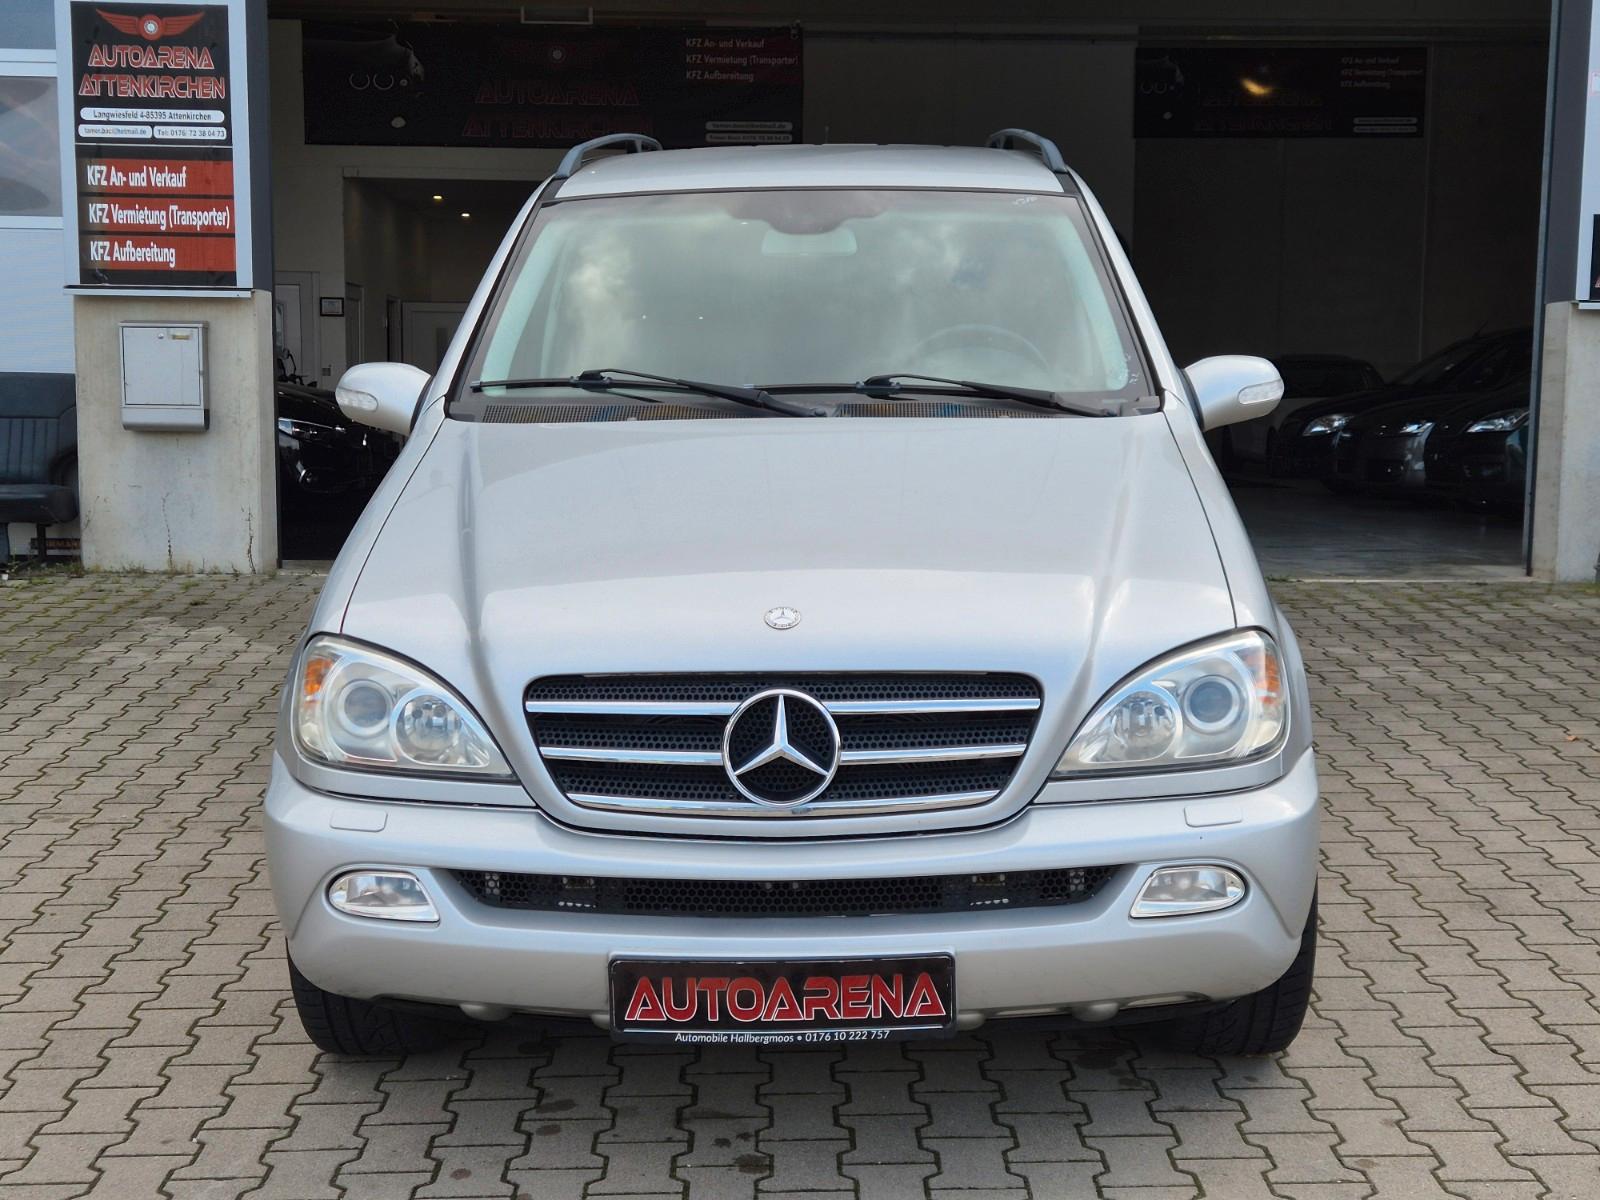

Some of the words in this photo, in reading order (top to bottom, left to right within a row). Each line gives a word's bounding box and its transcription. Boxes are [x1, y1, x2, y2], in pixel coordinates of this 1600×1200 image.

[686, 39, 701, 48] KFZ
[88, 45, 214, 69] AUTOARENA
[686, 54, 701, 63] KFZ
[79, 73, 225, 99] ATTENKIRCHEN
[686, 70, 701, 80] KFZ
[93, 109, 138, 120] Langwiesfeld
[168, 111, 212, 120] Attenkirchen
[87, 165, 107, 186] KFZ
[110, 165, 126, 187] An-
[129, 166, 147, 187] und
[149, 166, 187, 188] Verkauf
[89, 203, 110, 224] KFZ
[111, 204, 167, 231] Vermietung
[168, 204, 230, 231] (Transporter)
[90, 241, 111, 262] KFZ
[113, 240, 176, 268] Aufbereitung
[624, 972, 946, 1021] AUTOARENA
[674, 1033, 728, 1043] Automobile
[730, 1033, 794, 1044] Hallbergmoos
[805, 1031, 831, 1042] 0176
[833, 1031, 847, 1041] 10
[848, 1030, 868, 1041] 222
[870, 1029, 890, 1040] 757
